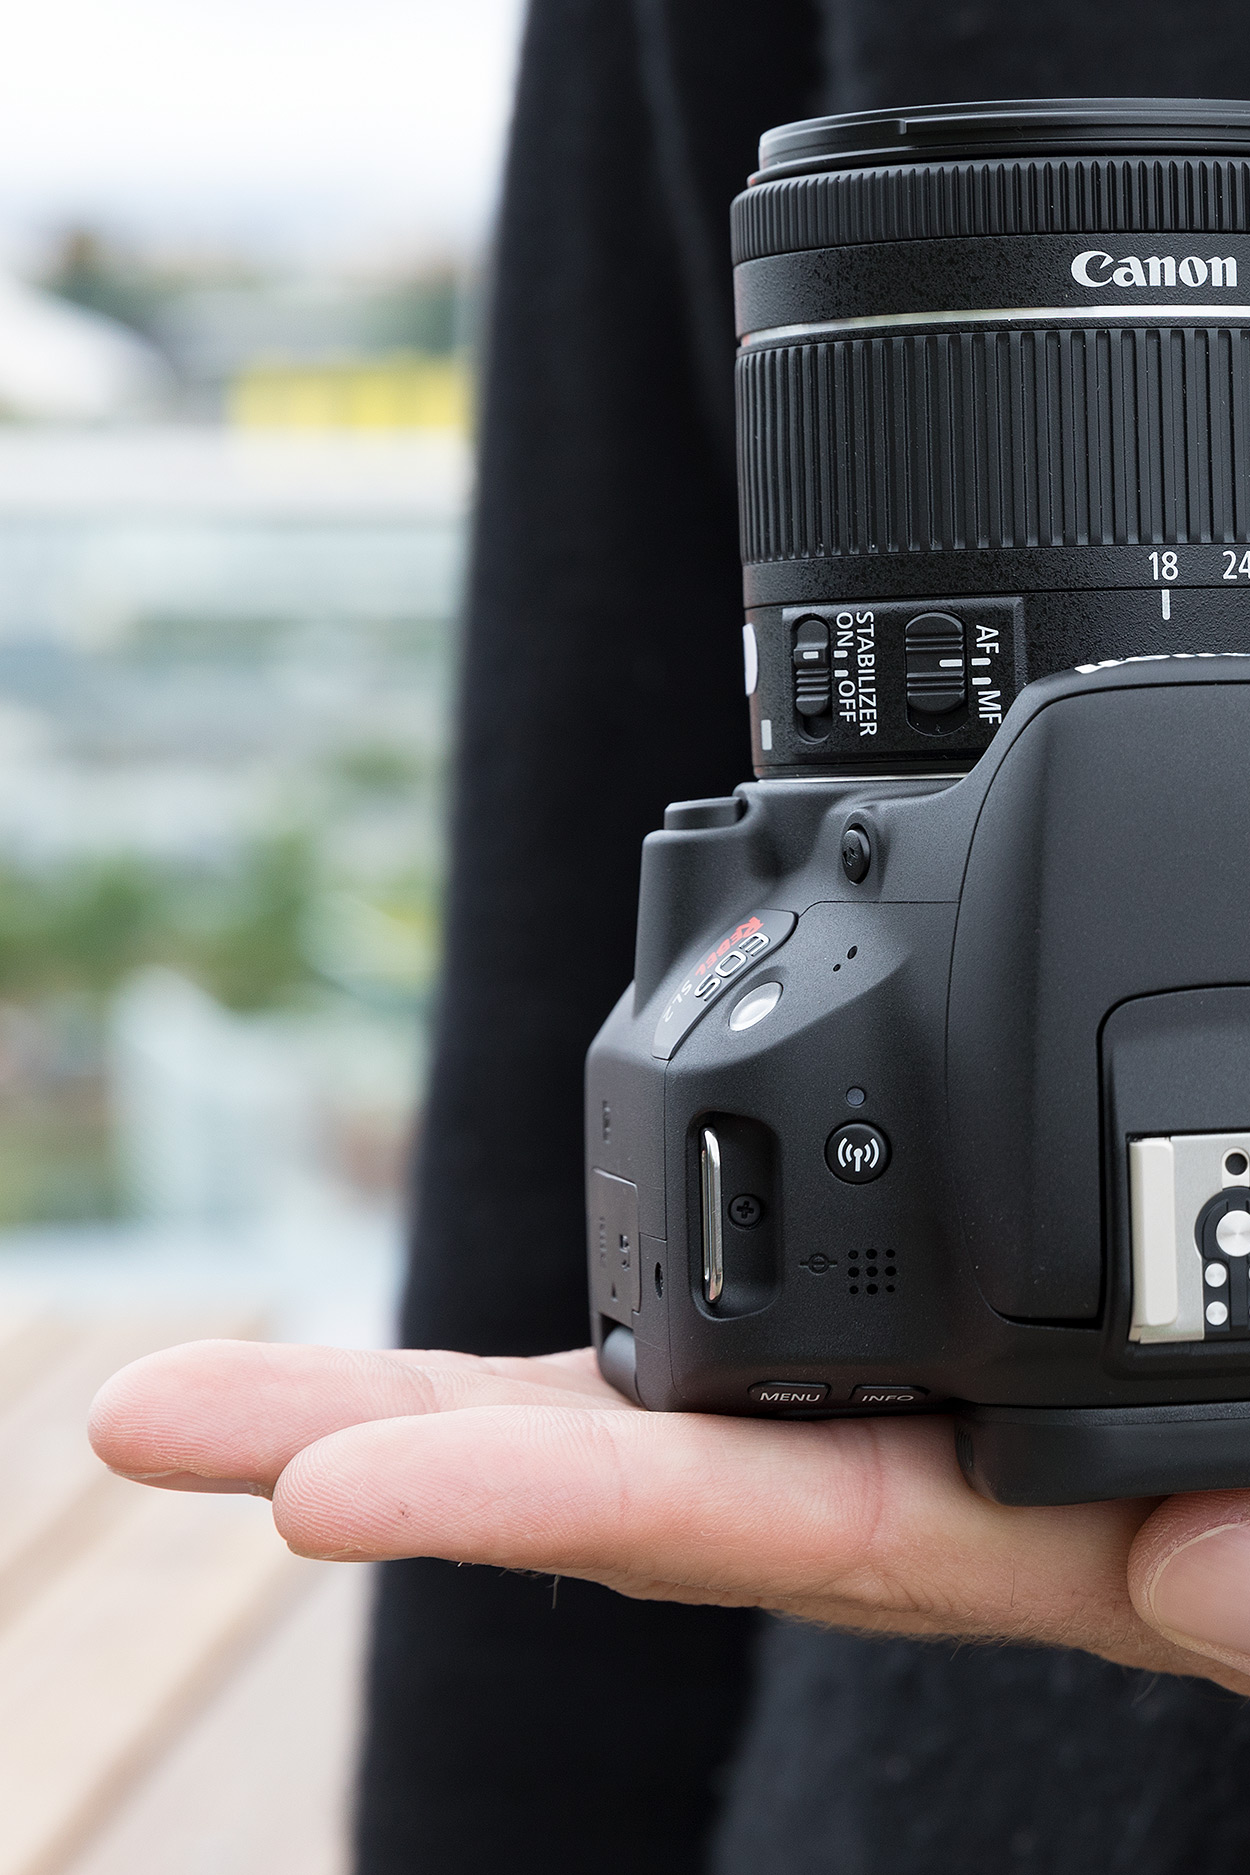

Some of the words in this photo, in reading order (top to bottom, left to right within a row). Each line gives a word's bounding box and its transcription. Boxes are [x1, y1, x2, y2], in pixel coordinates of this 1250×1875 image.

[1071, 250, 1238, 288] Canon
[1148, 551, 1179, 581] 18
[836, 611, 854, 647] ON
[975, 624, 1000, 654] AF
[856, 611, 878, 737] STABILIZER
[838, 680, 857, 723] OFF
[977, 690, 1002, 724] MF
[694, 932, 770, 1001] EOS
[662, 979, 693, 1023] SL2
[760, 1392, 821, 1402] MENU
